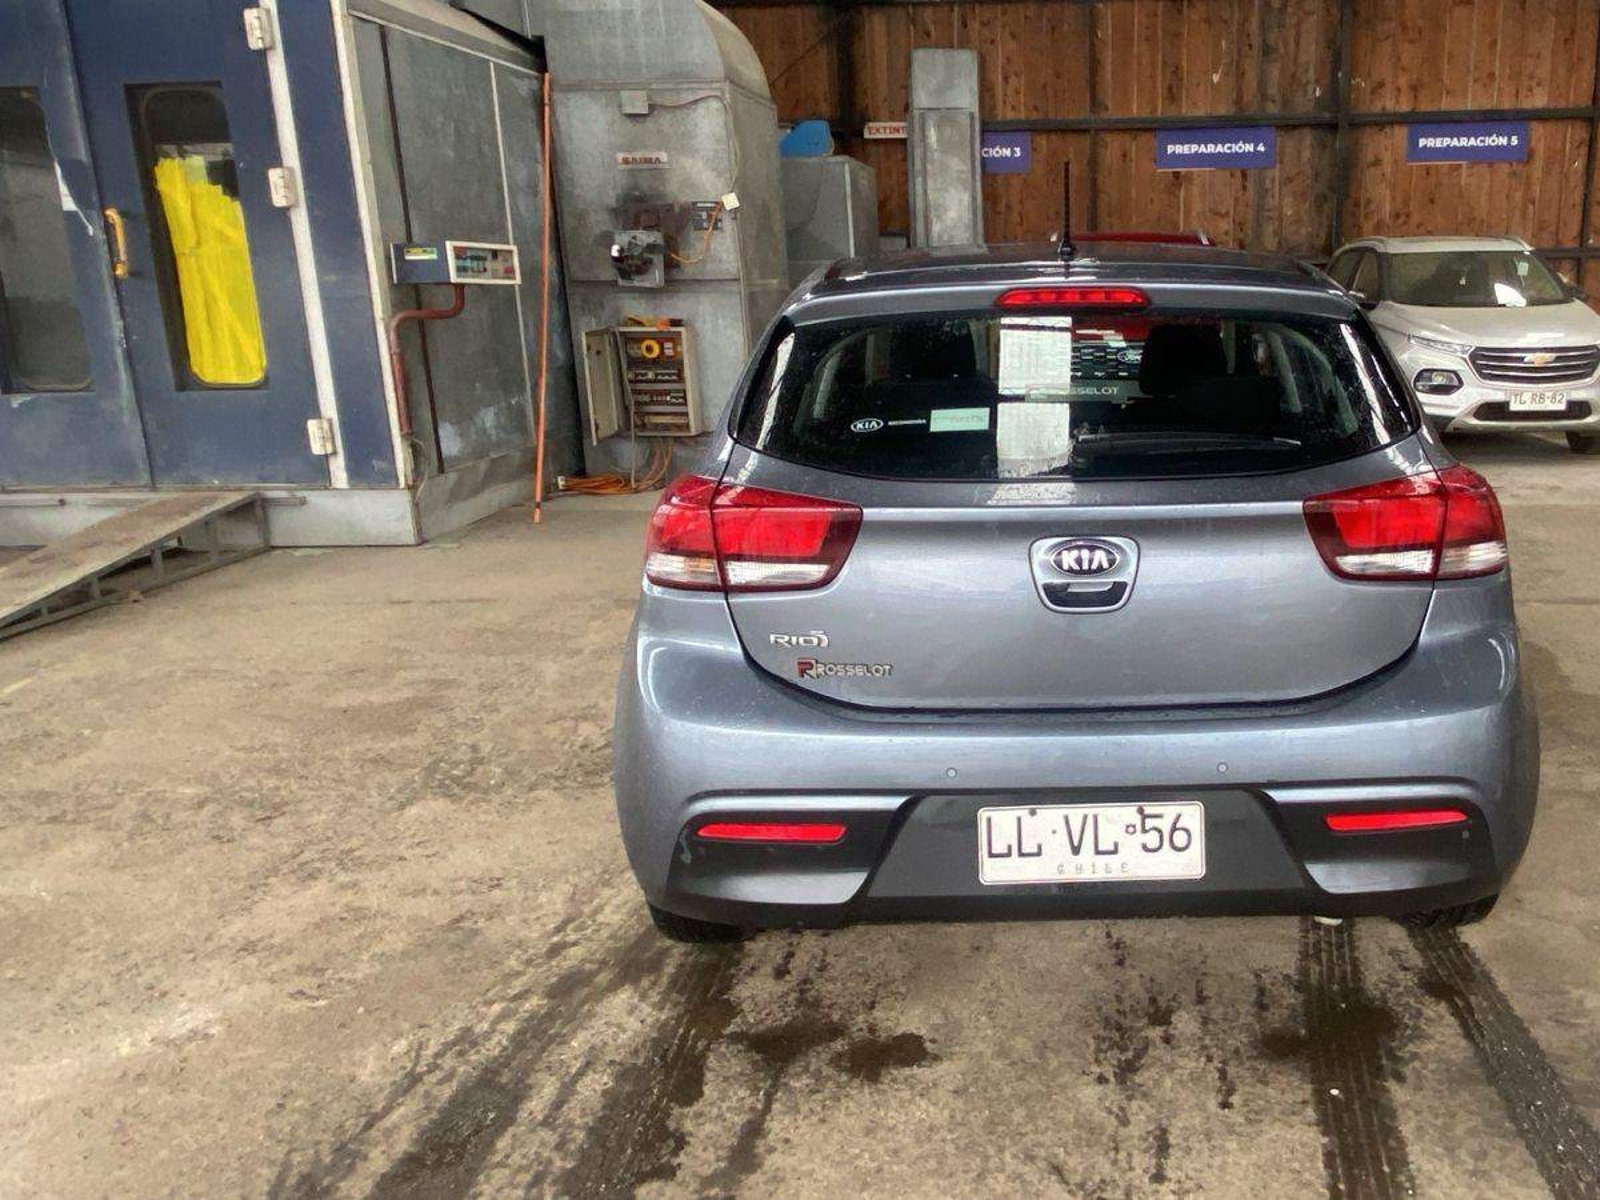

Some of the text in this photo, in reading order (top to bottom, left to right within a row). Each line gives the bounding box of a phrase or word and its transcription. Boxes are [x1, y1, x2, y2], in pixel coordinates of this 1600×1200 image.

[1166, 141, 1266, 155] PREPARACIÓN 4
[1418, 134, 1519, 149] PREPARACIÓN 5
[1013, 147, 1022, 158] 3
[854, 419, 880, 431] KIA
[1060, 548, 1110, 571] KIA
